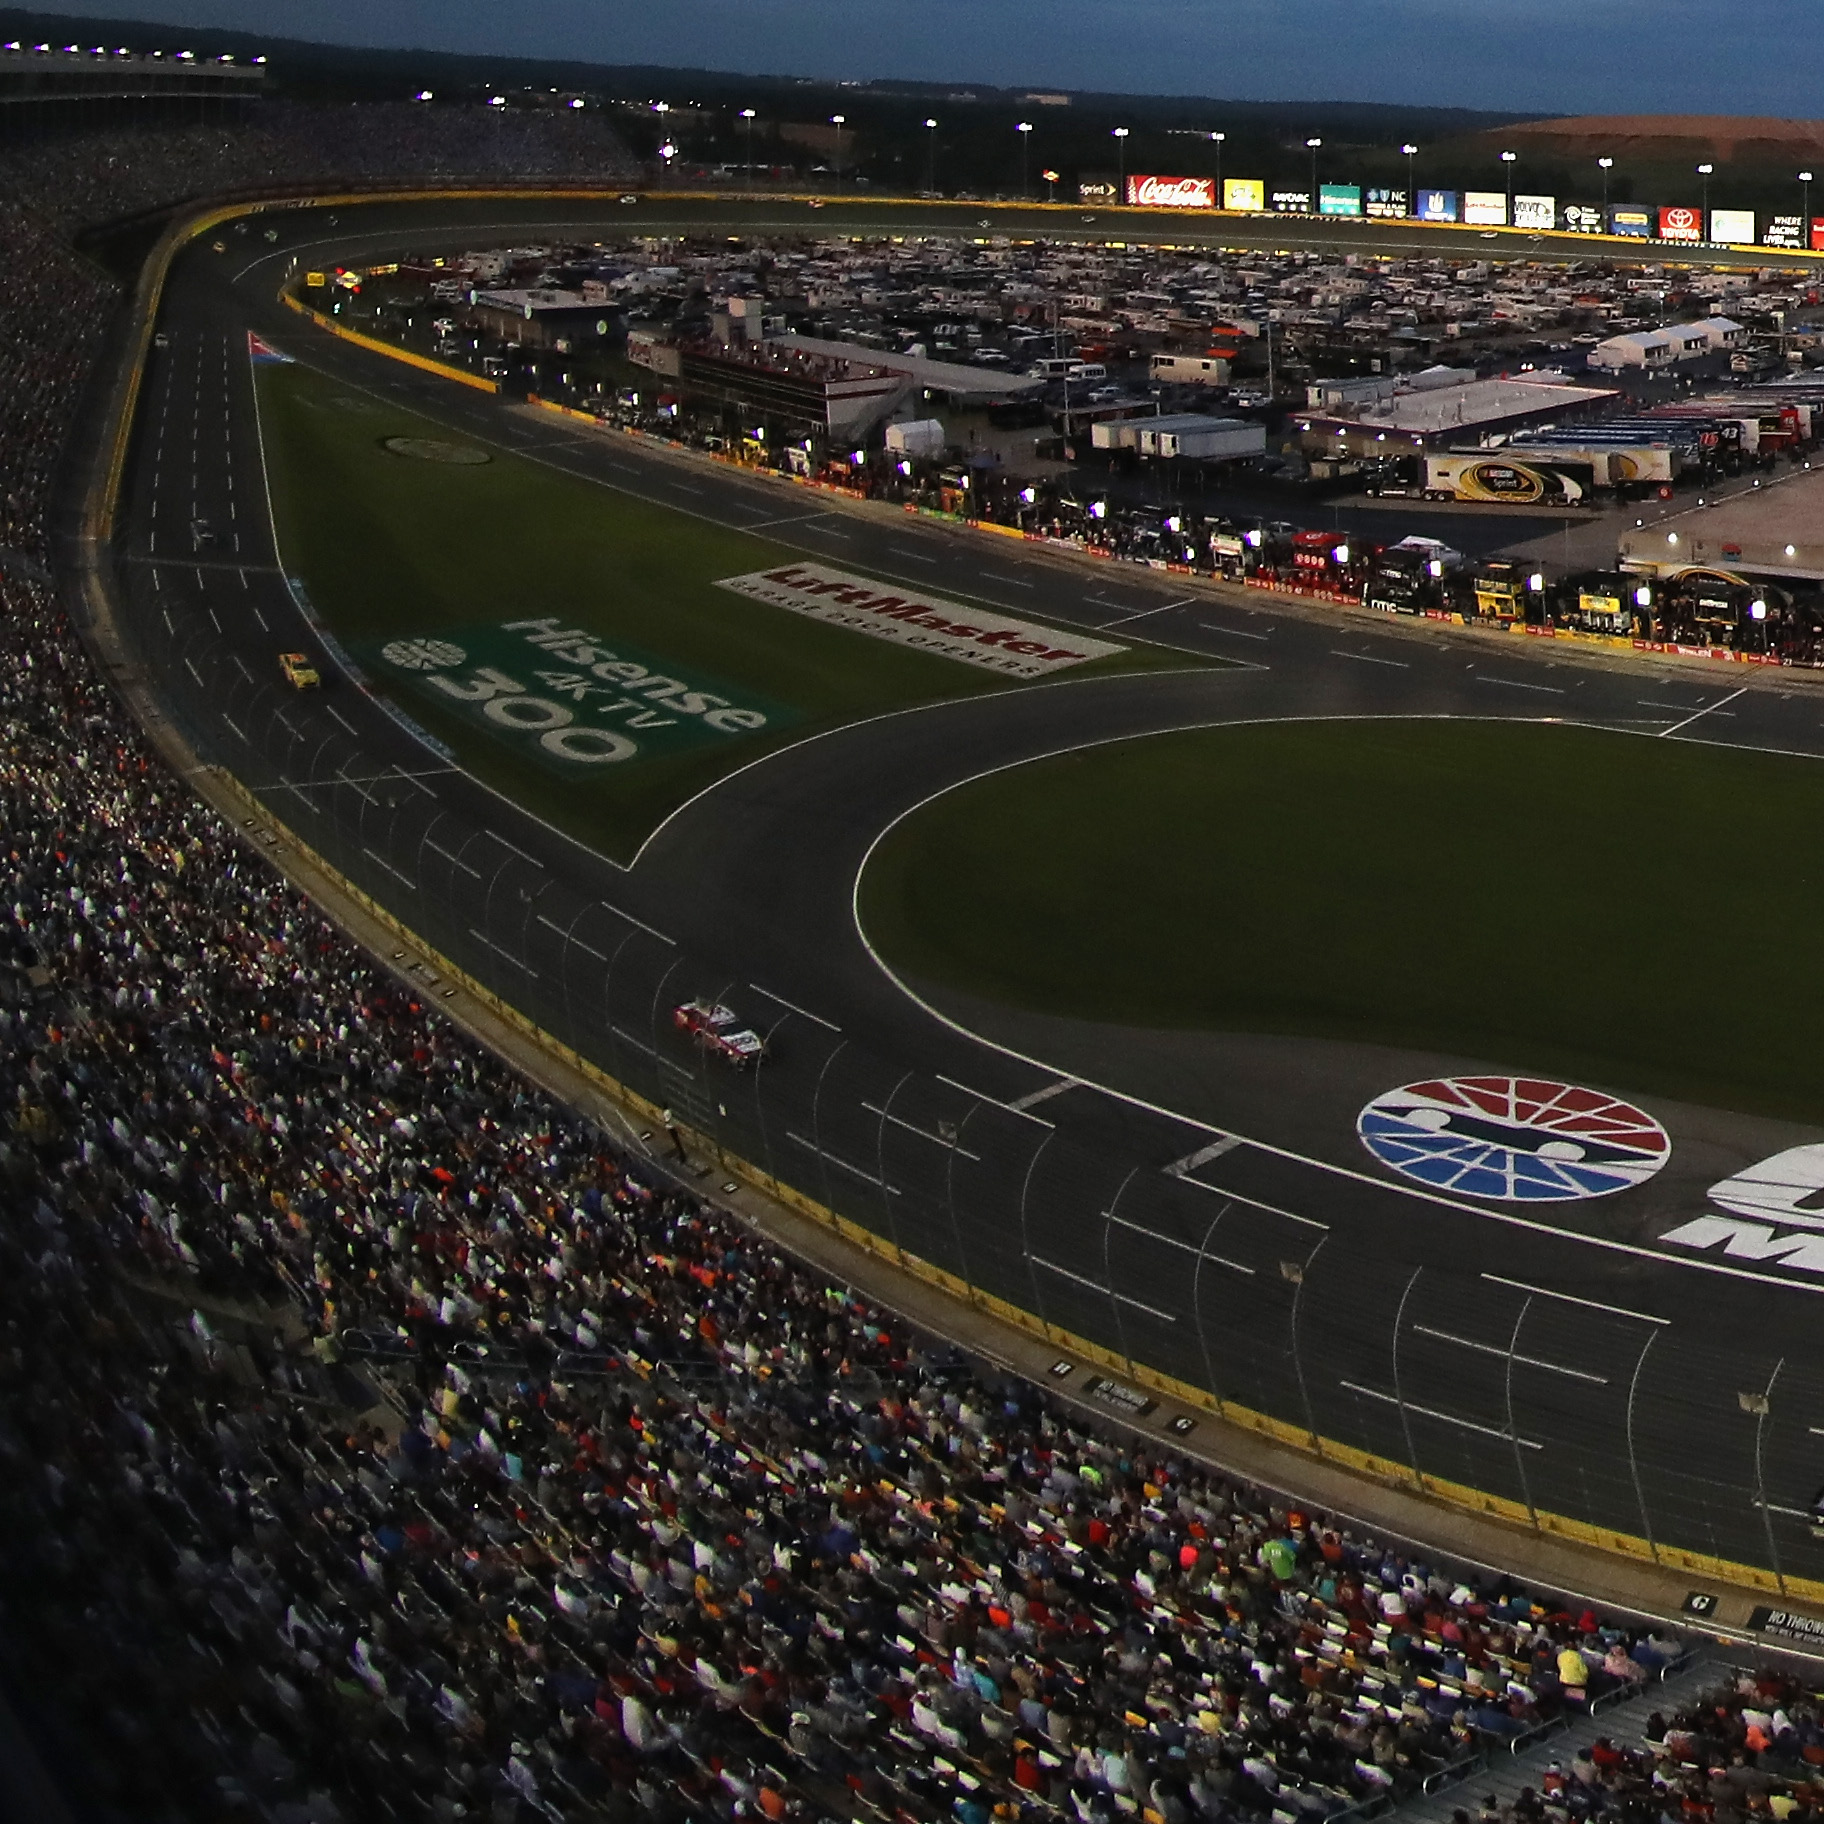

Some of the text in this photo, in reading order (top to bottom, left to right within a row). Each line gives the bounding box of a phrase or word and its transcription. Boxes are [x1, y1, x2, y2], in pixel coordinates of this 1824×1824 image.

[1080, 184, 1105, 196] Sprint
[1139, 177, 1212, 206] Coca-Cola
[1391, 190, 1406, 202] NC
[1661, 228, 1699, 240] TOYOTA
[1721, 427, 1738, 439] 43
[762, 568, 1087, 660] LiftMaster
[905, 635, 1041, 675] OPENERS
[501, 618, 767, 732] Hisense
[426, 667, 638, 763] 300
[598, 697, 679, 729] TV
[1768, 1610, 1785, 1624] NO
